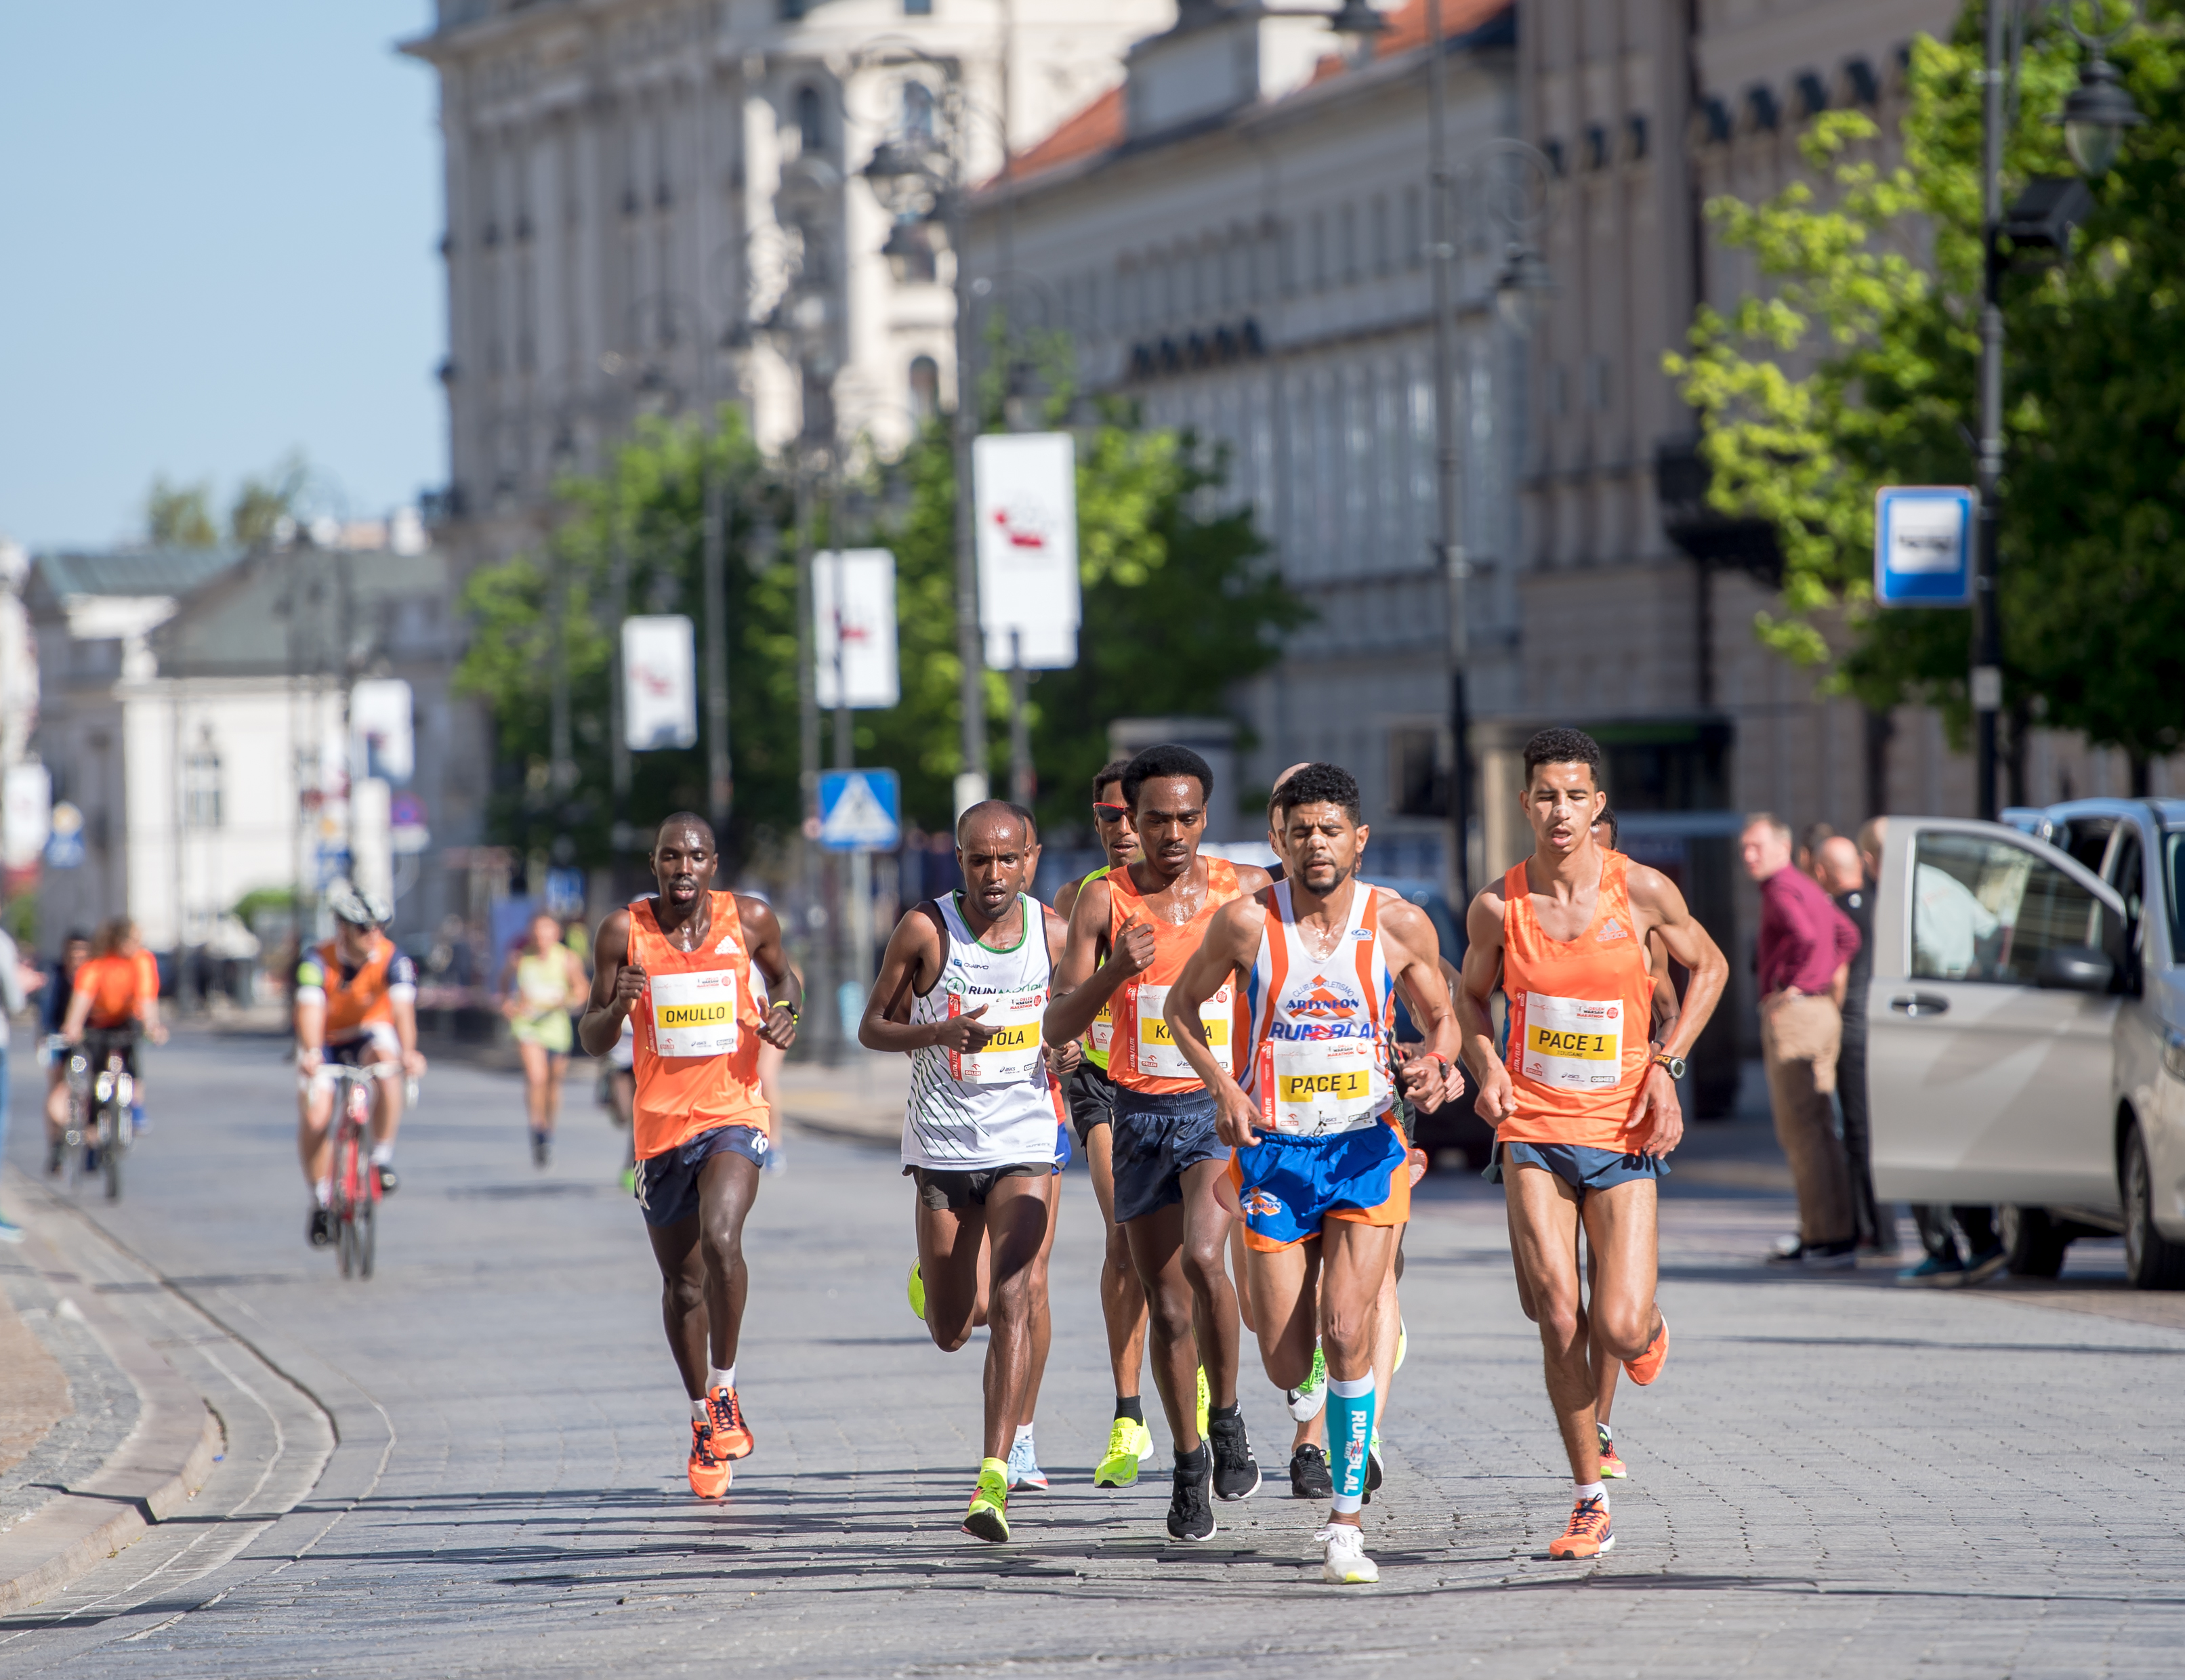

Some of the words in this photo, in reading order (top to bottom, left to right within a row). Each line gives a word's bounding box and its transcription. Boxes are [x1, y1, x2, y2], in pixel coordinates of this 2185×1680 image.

[1292, 984, 1310, 997] CLUB
[1286, 998, 1359, 1009] ARTYNEON
[666, 1007, 725, 1023] OMULLO
[1539, 1029, 1589, 1051] PACE
[1593, 1036, 1604, 1052] 1
[1291, 1075, 1341, 1094] PACE
[1347, 1074, 1358, 1091] 1
